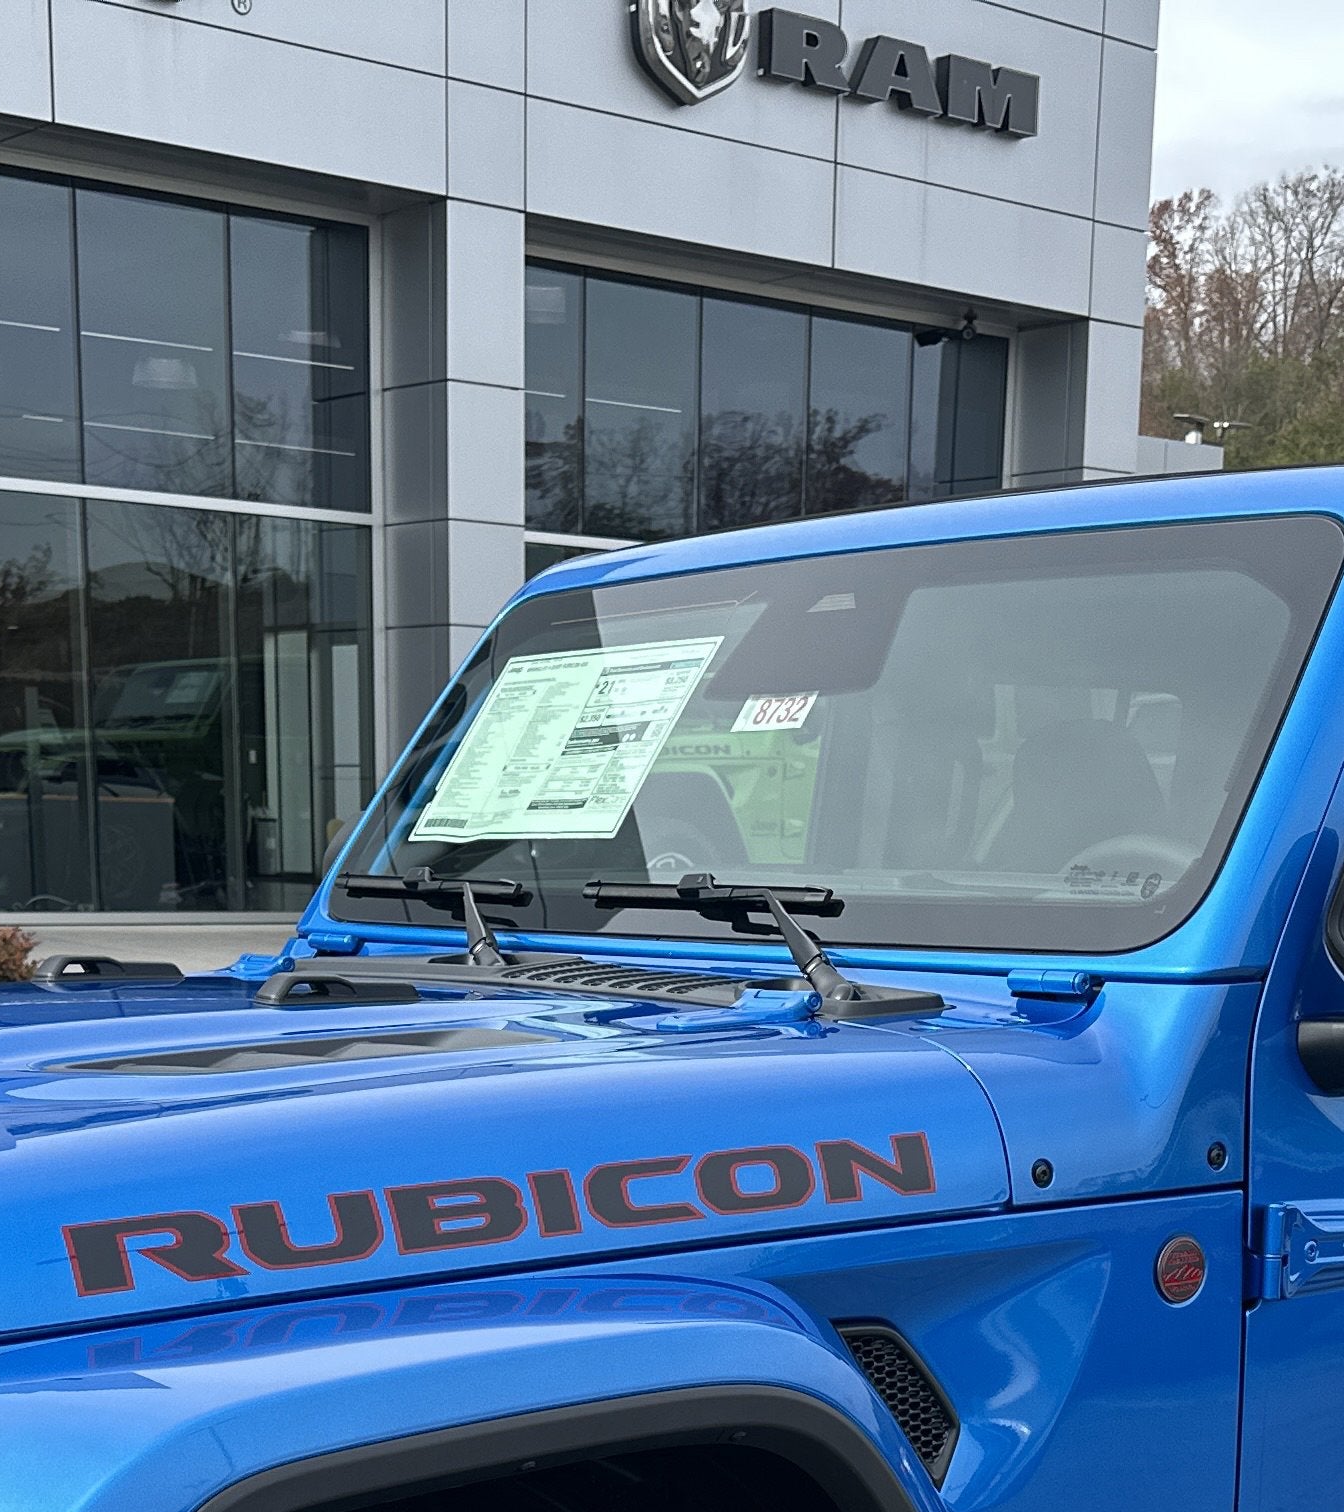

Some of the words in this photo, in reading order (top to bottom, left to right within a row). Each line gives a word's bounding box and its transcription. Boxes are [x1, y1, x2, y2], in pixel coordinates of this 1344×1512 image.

[758, 7, 1040, 137] RAM
[752, 696, 809, 725] 8732
[61, 1131, 938, 1298] RUBICON
